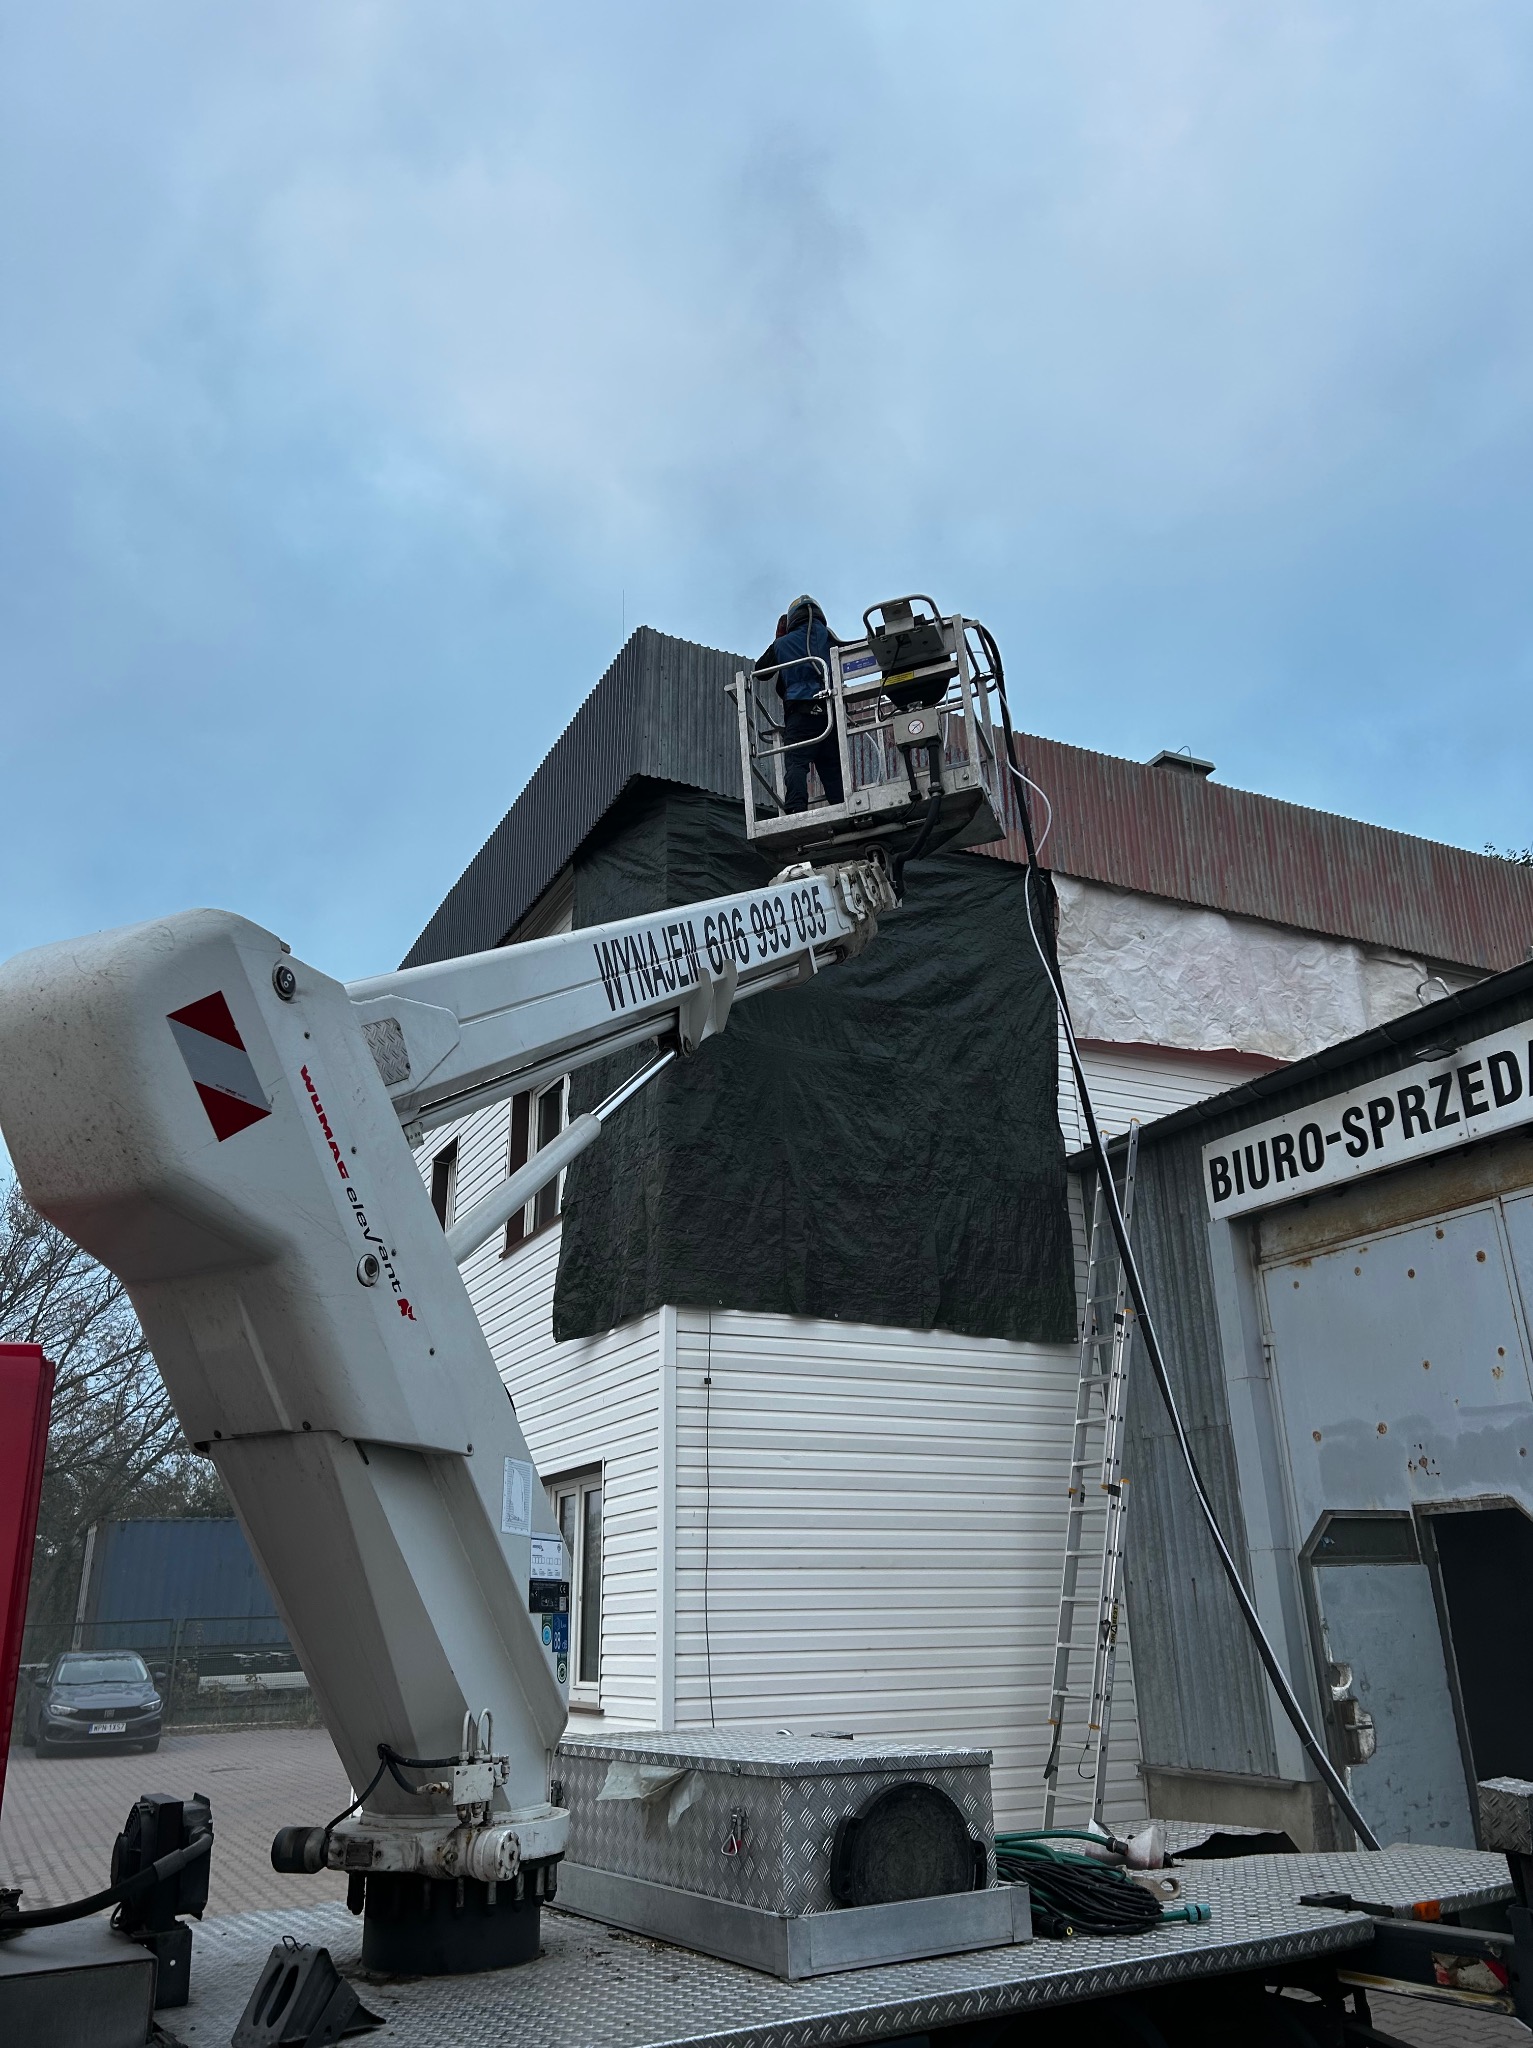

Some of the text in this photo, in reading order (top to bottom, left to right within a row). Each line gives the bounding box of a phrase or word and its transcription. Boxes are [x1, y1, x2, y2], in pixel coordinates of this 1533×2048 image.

[593, 885, 828, 1011] WYNAJEM 606 993 035
[300, 1064, 402, 1292] WUMAG elevant
